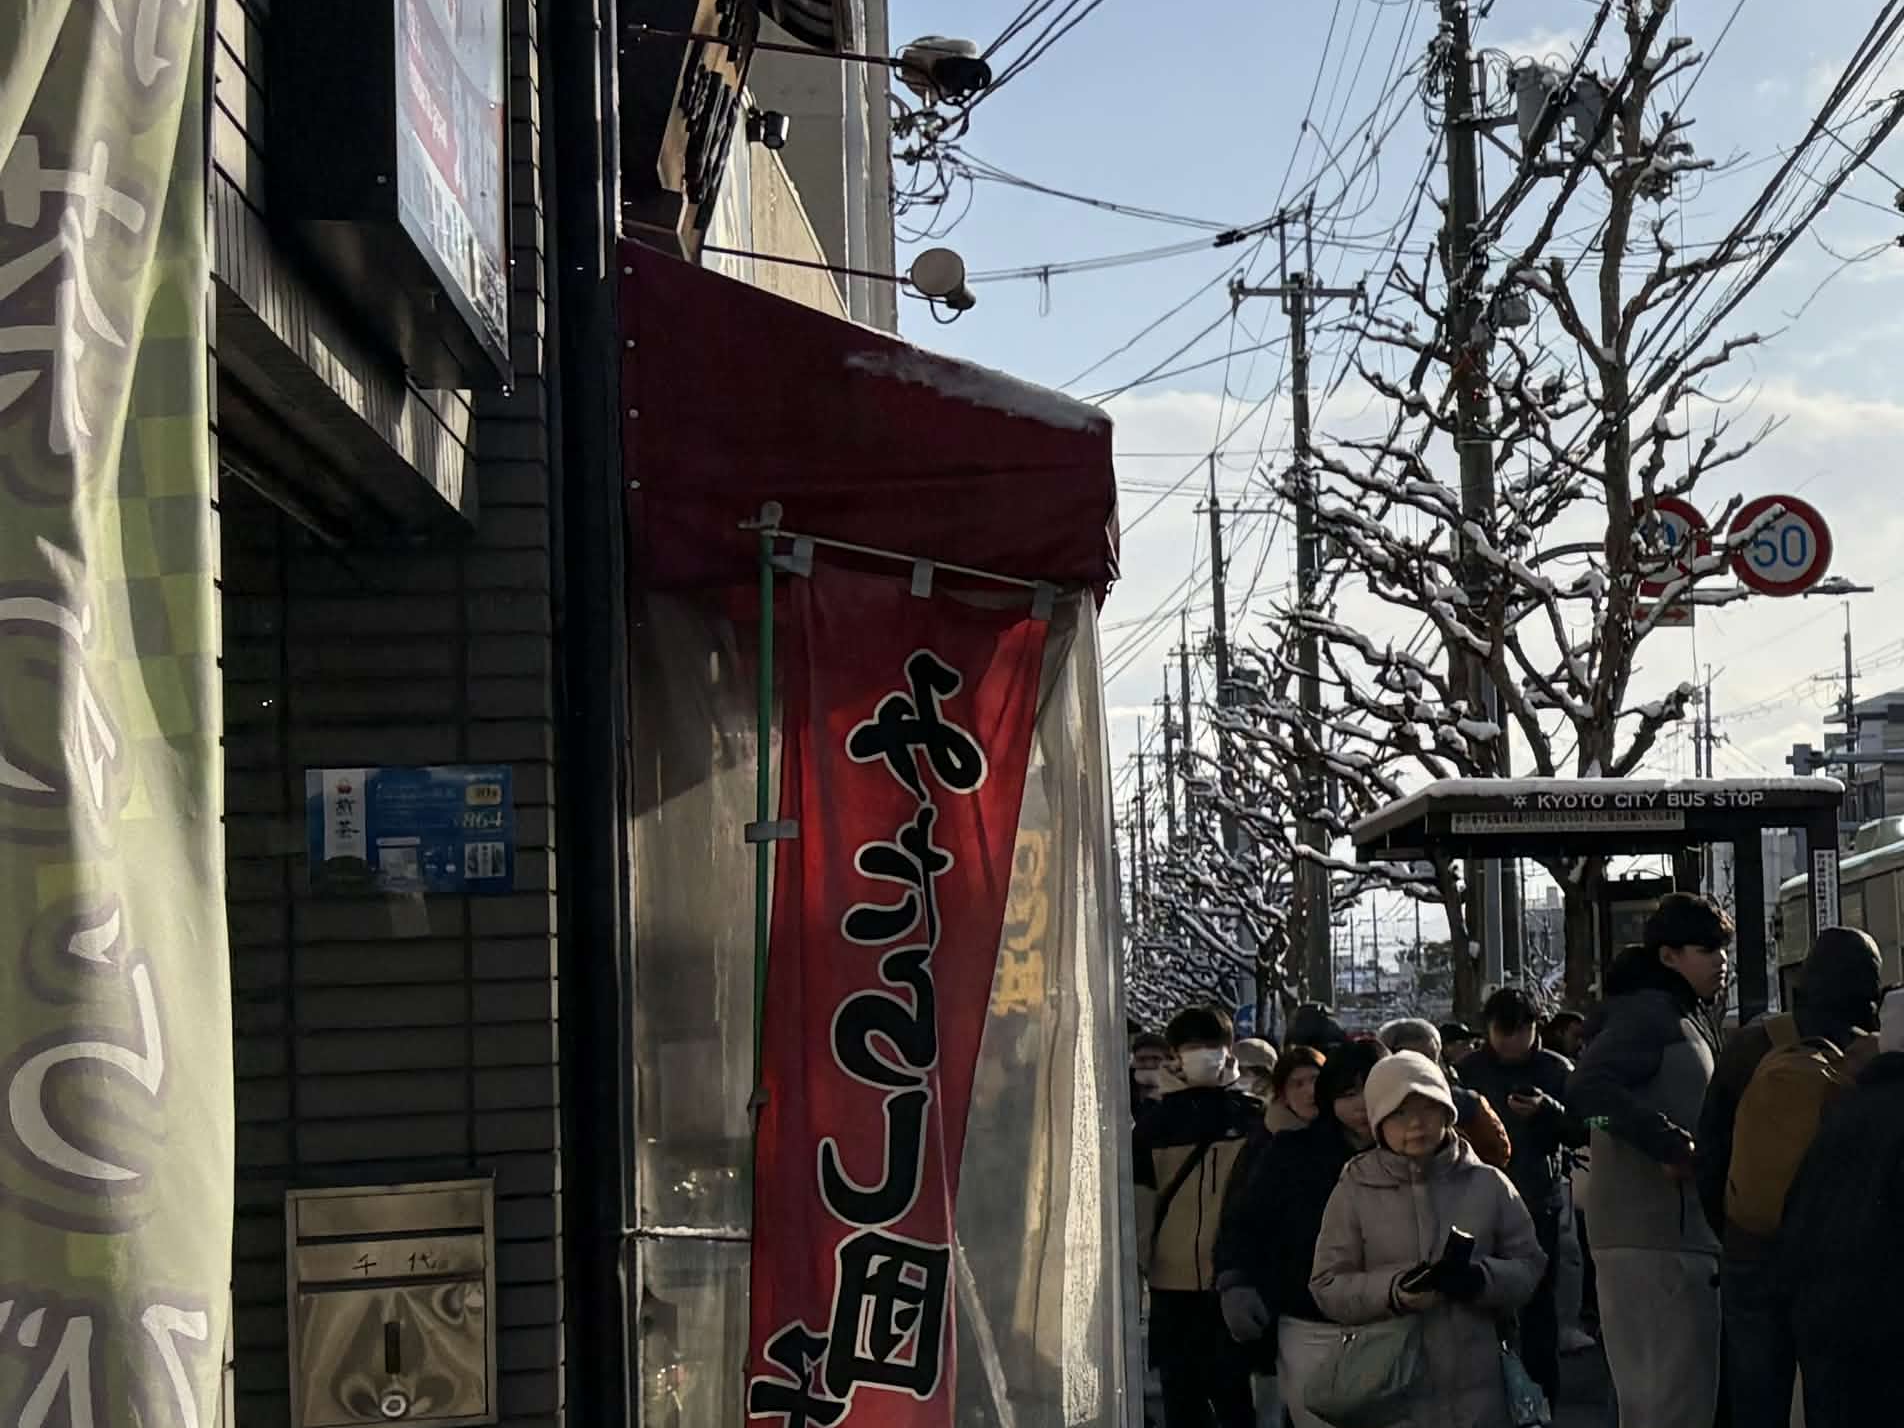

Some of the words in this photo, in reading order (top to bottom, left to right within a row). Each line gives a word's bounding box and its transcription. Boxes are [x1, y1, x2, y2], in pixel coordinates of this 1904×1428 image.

[1753, 525, 1807, 567] 50
[1537, 794, 1605, 809] KYOTO
[1615, 793, 1659, 809] CITY
[1667, 792, 1706, 808] BUS
[1713, 791, 1764, 808] STOP
